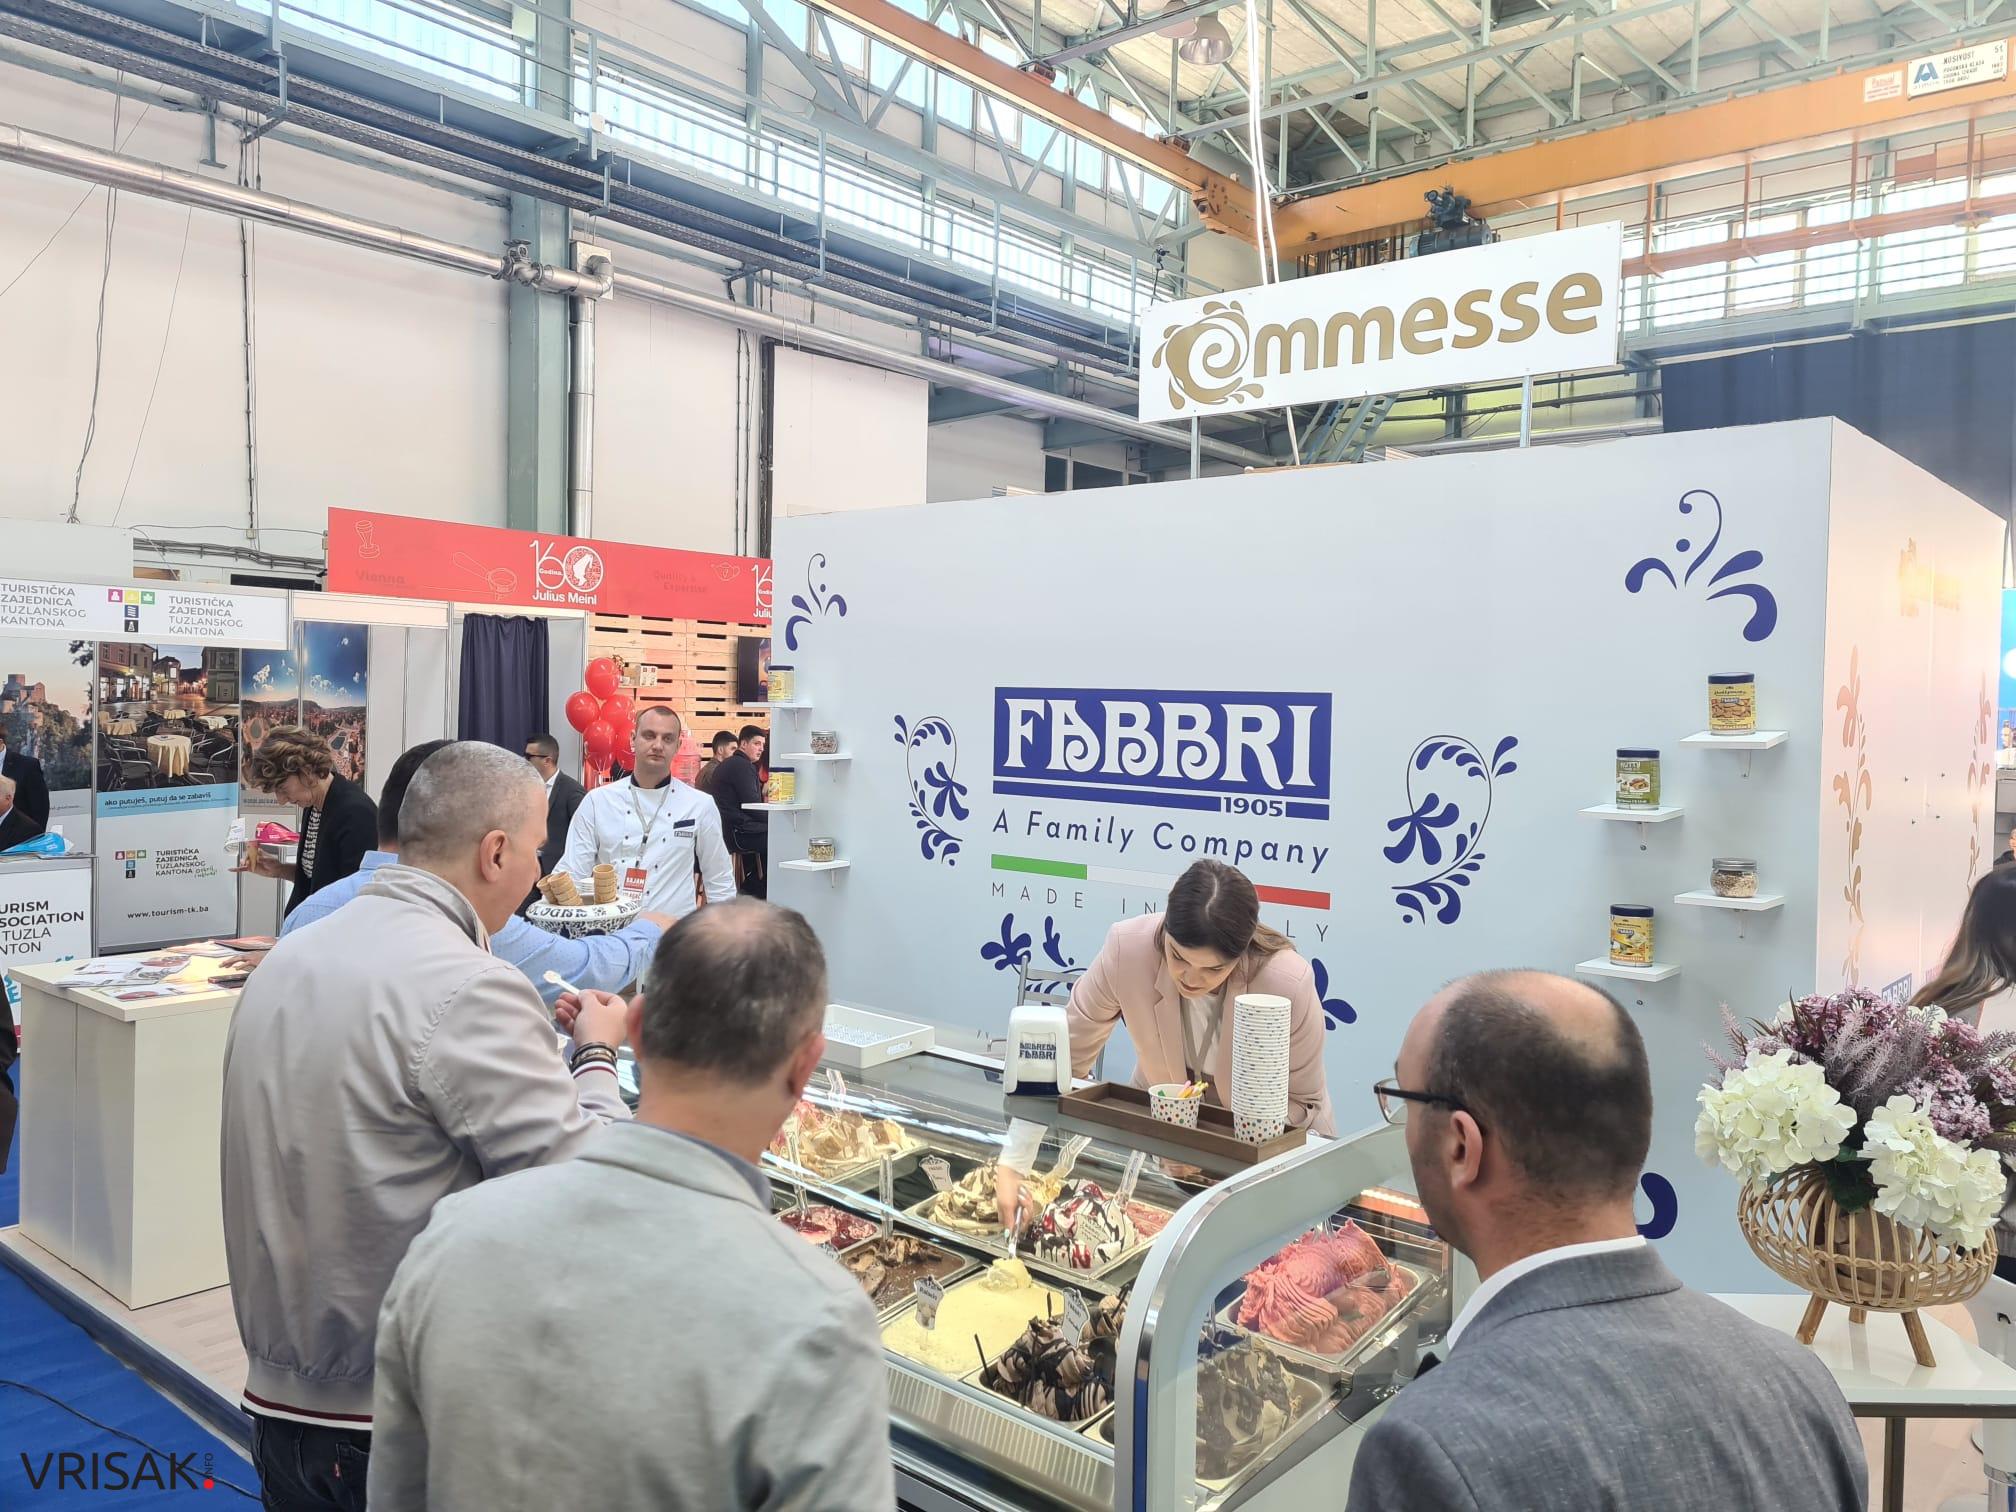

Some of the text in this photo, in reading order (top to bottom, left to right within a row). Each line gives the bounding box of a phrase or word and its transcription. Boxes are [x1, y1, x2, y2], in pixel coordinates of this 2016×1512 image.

[1, 583, 76, 597] TURISTIČKA
[1, 594, 73, 607] ZAJEDNICA
[169, 595, 234, 608] TURISTIČKA
[532, 589, 598, 605] Julius Meinl
[1, 604, 87, 618] TUZLANSKOG
[169, 606, 232, 617] ZAJEDNICA
[1, 615, 65, 627] KANTONA
[169, 616, 243, 628] TUZLANSKOG
[169, 626, 225, 636] KANTONA
[1002, 698, 1319, 790] FABBRI
[149, 796, 167, 804] putuj
[1223, 796, 1283, 817] 1905
[993, 809, 1330, 874] A Family Company
[156, 848, 200, 857] TURISTIČKA
[156, 855, 198, 864] ZAJEDNICA
[156, 861, 206, 870] TUZLANSKOG
[156, 868, 193, 877] KANTONA
[992, 882, 1157, 915] MADE IN
[2, 927, 51, 941] TUZLA
